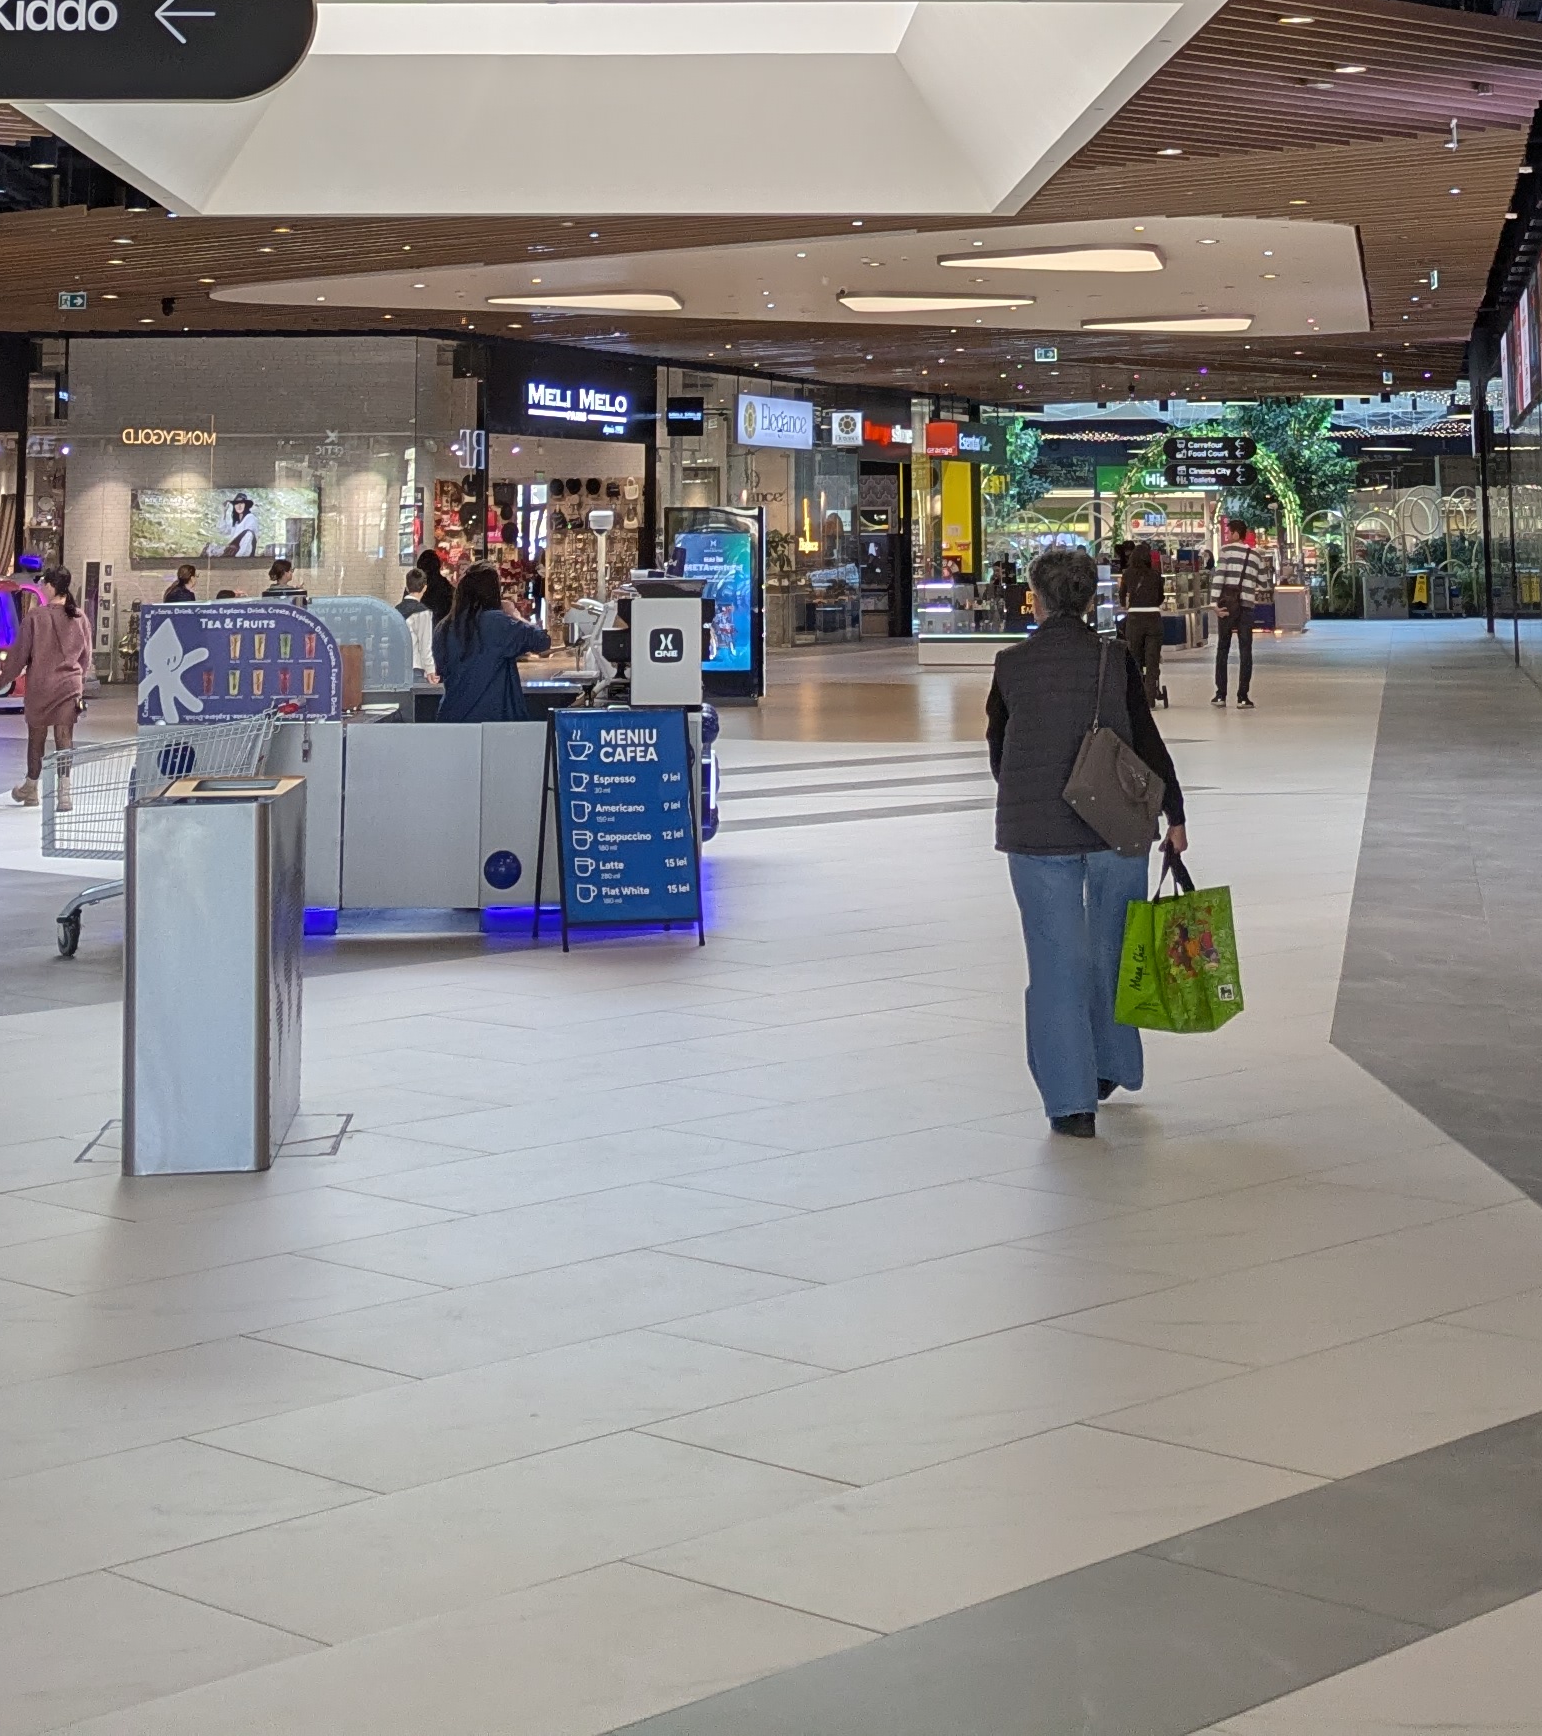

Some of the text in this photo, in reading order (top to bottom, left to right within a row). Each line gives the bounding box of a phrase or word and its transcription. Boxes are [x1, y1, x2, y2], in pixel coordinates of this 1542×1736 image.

[528, 383, 627, 413] MELI MELO
[761, 403, 807, 439] Elegance
[199, 618, 276, 629] TEA & FRUITS
[654, 649, 678, 658] ONE
[600, 728, 657, 745] MENIU
[599, 746, 658, 763] CAFEA
[593, 772, 681, 786] Espresso 9 lei
[595, 801, 681, 813] Americano 9 lei
[597, 829, 684, 843] Cappuccino 12 lei
[599, 857, 688, 870] Latte 15 lei
[601, 883, 690, 896] Flat White 15 lei
